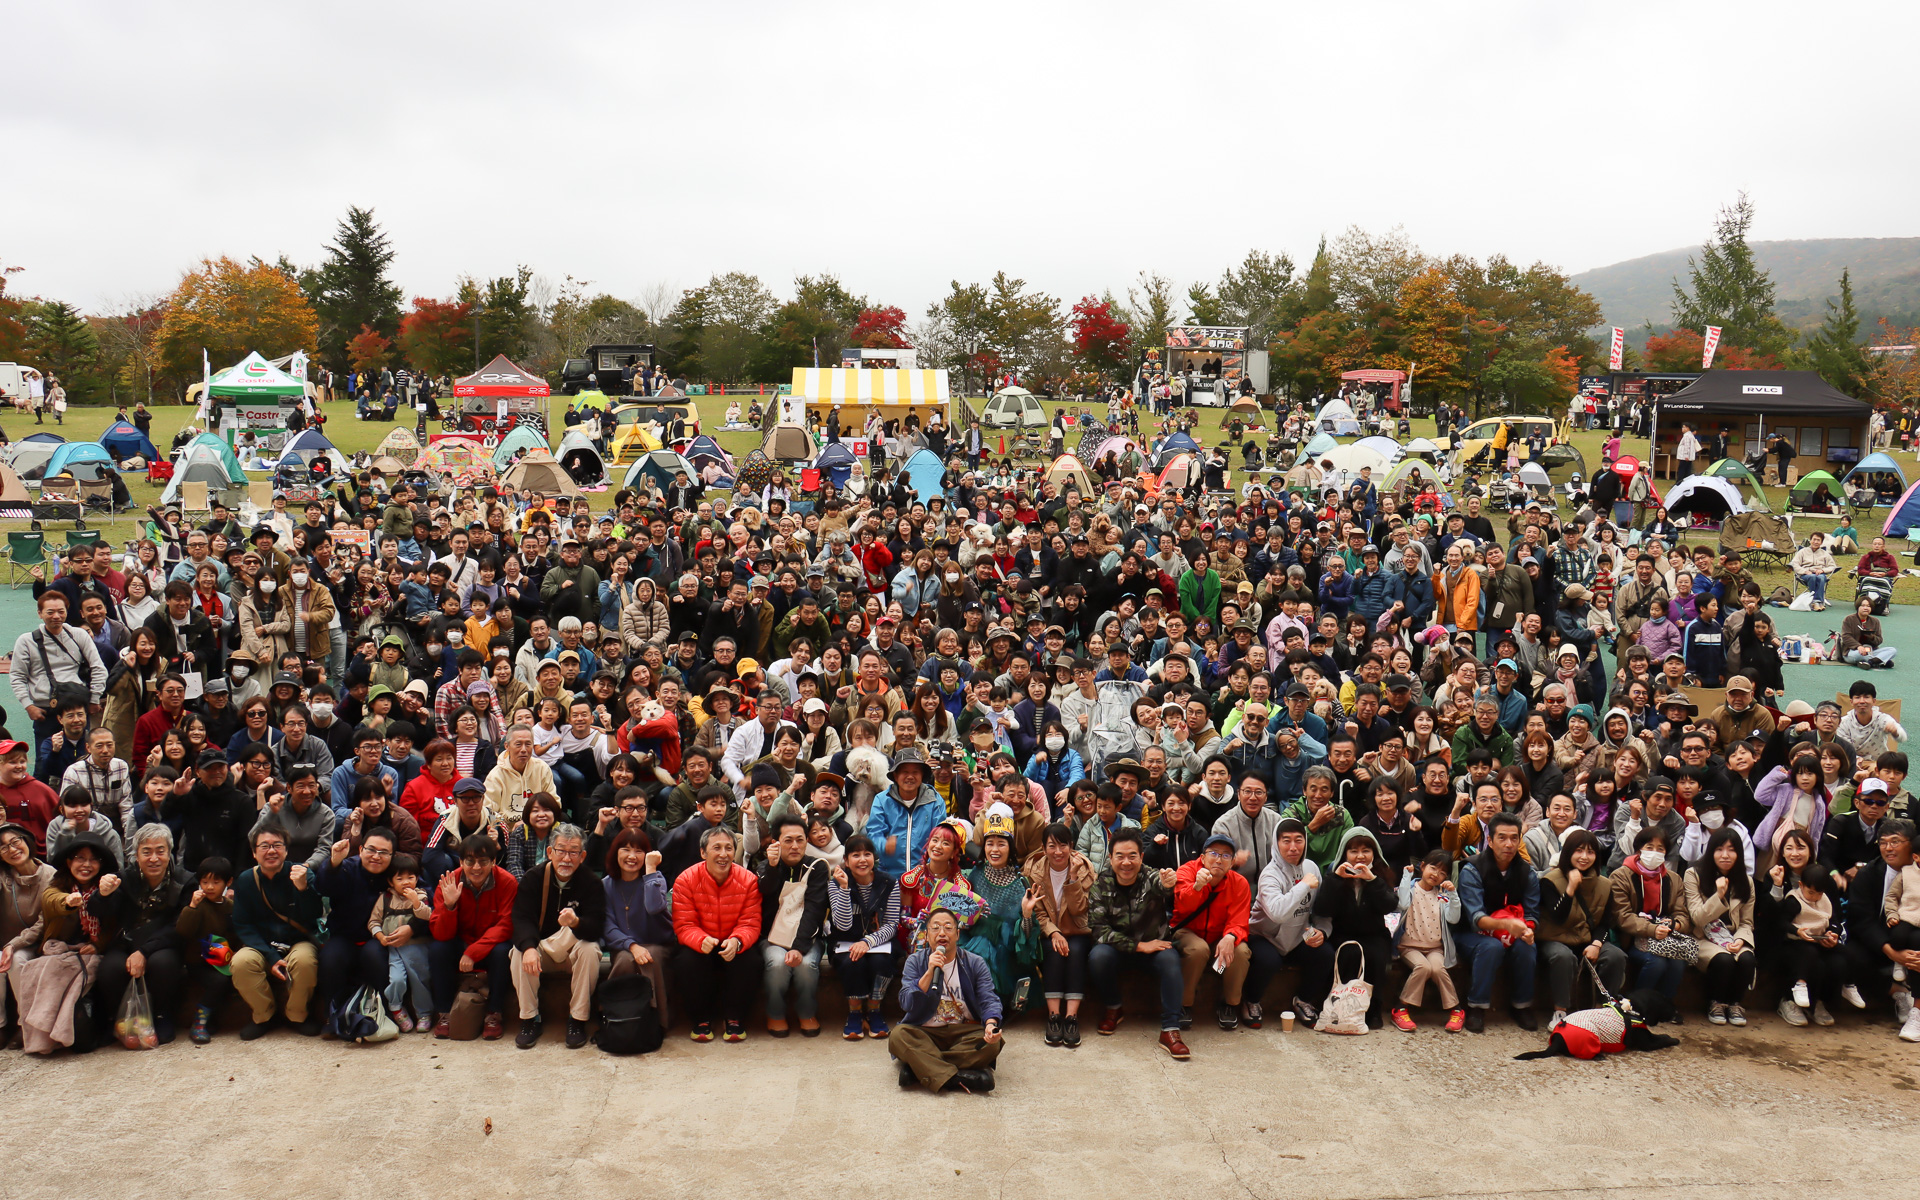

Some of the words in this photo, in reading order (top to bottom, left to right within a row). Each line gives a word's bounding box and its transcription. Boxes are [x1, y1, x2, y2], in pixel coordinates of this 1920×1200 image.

[1199, 328, 1244, 339] 牛ステーキ
[1208, 339, 1234, 349] 専門店
[1610, 327, 1624, 364] pizza
